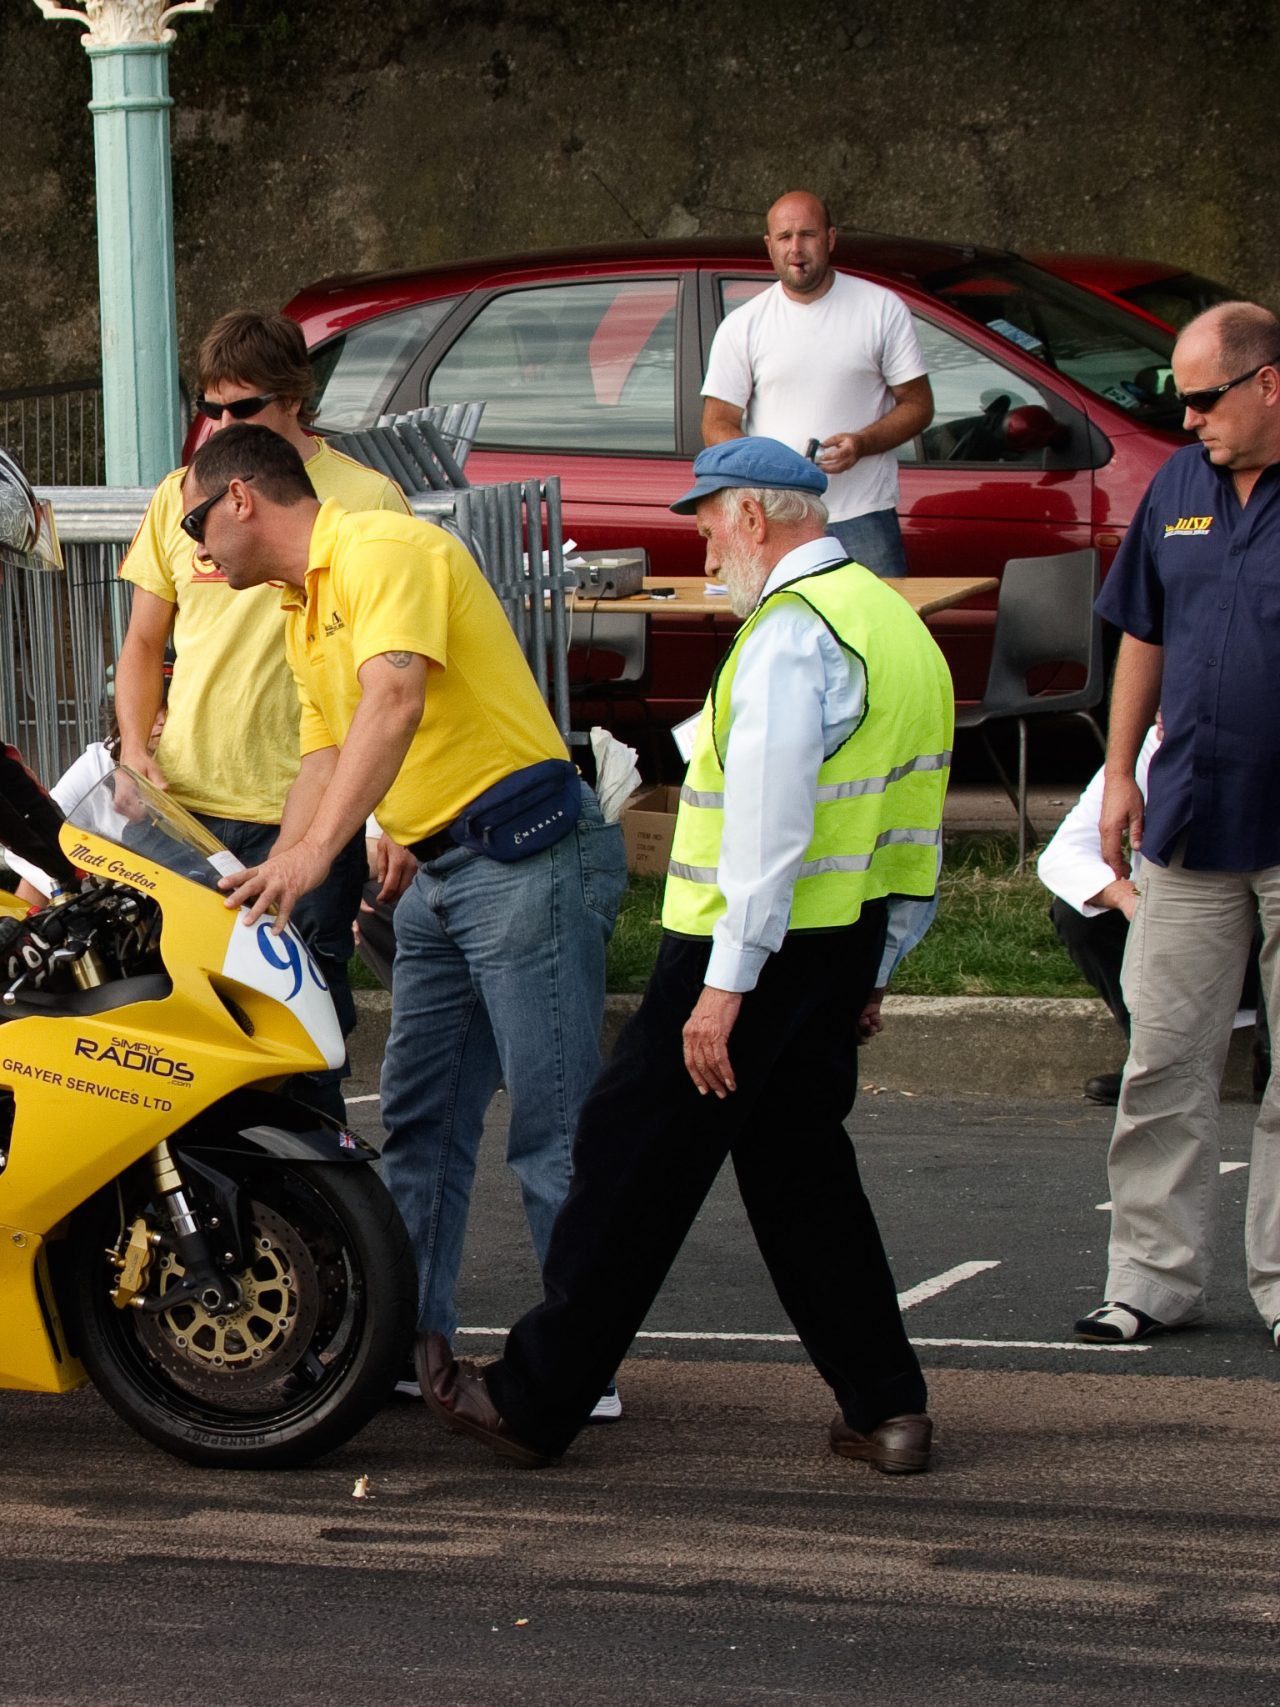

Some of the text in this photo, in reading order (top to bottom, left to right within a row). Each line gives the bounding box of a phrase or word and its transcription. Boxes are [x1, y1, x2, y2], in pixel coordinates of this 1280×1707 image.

[513, 810, 564, 845] EMERALD
[68, 843, 157, 891] Matt Gretton
[74, 1037, 195, 1082] RADIOS
[111, 1036, 165, 1056] SIMPLY
[2, 1058, 173, 1112] GRAYER SERVICES LTD
[182, 1428, 266, 1447] RENNSPORT
